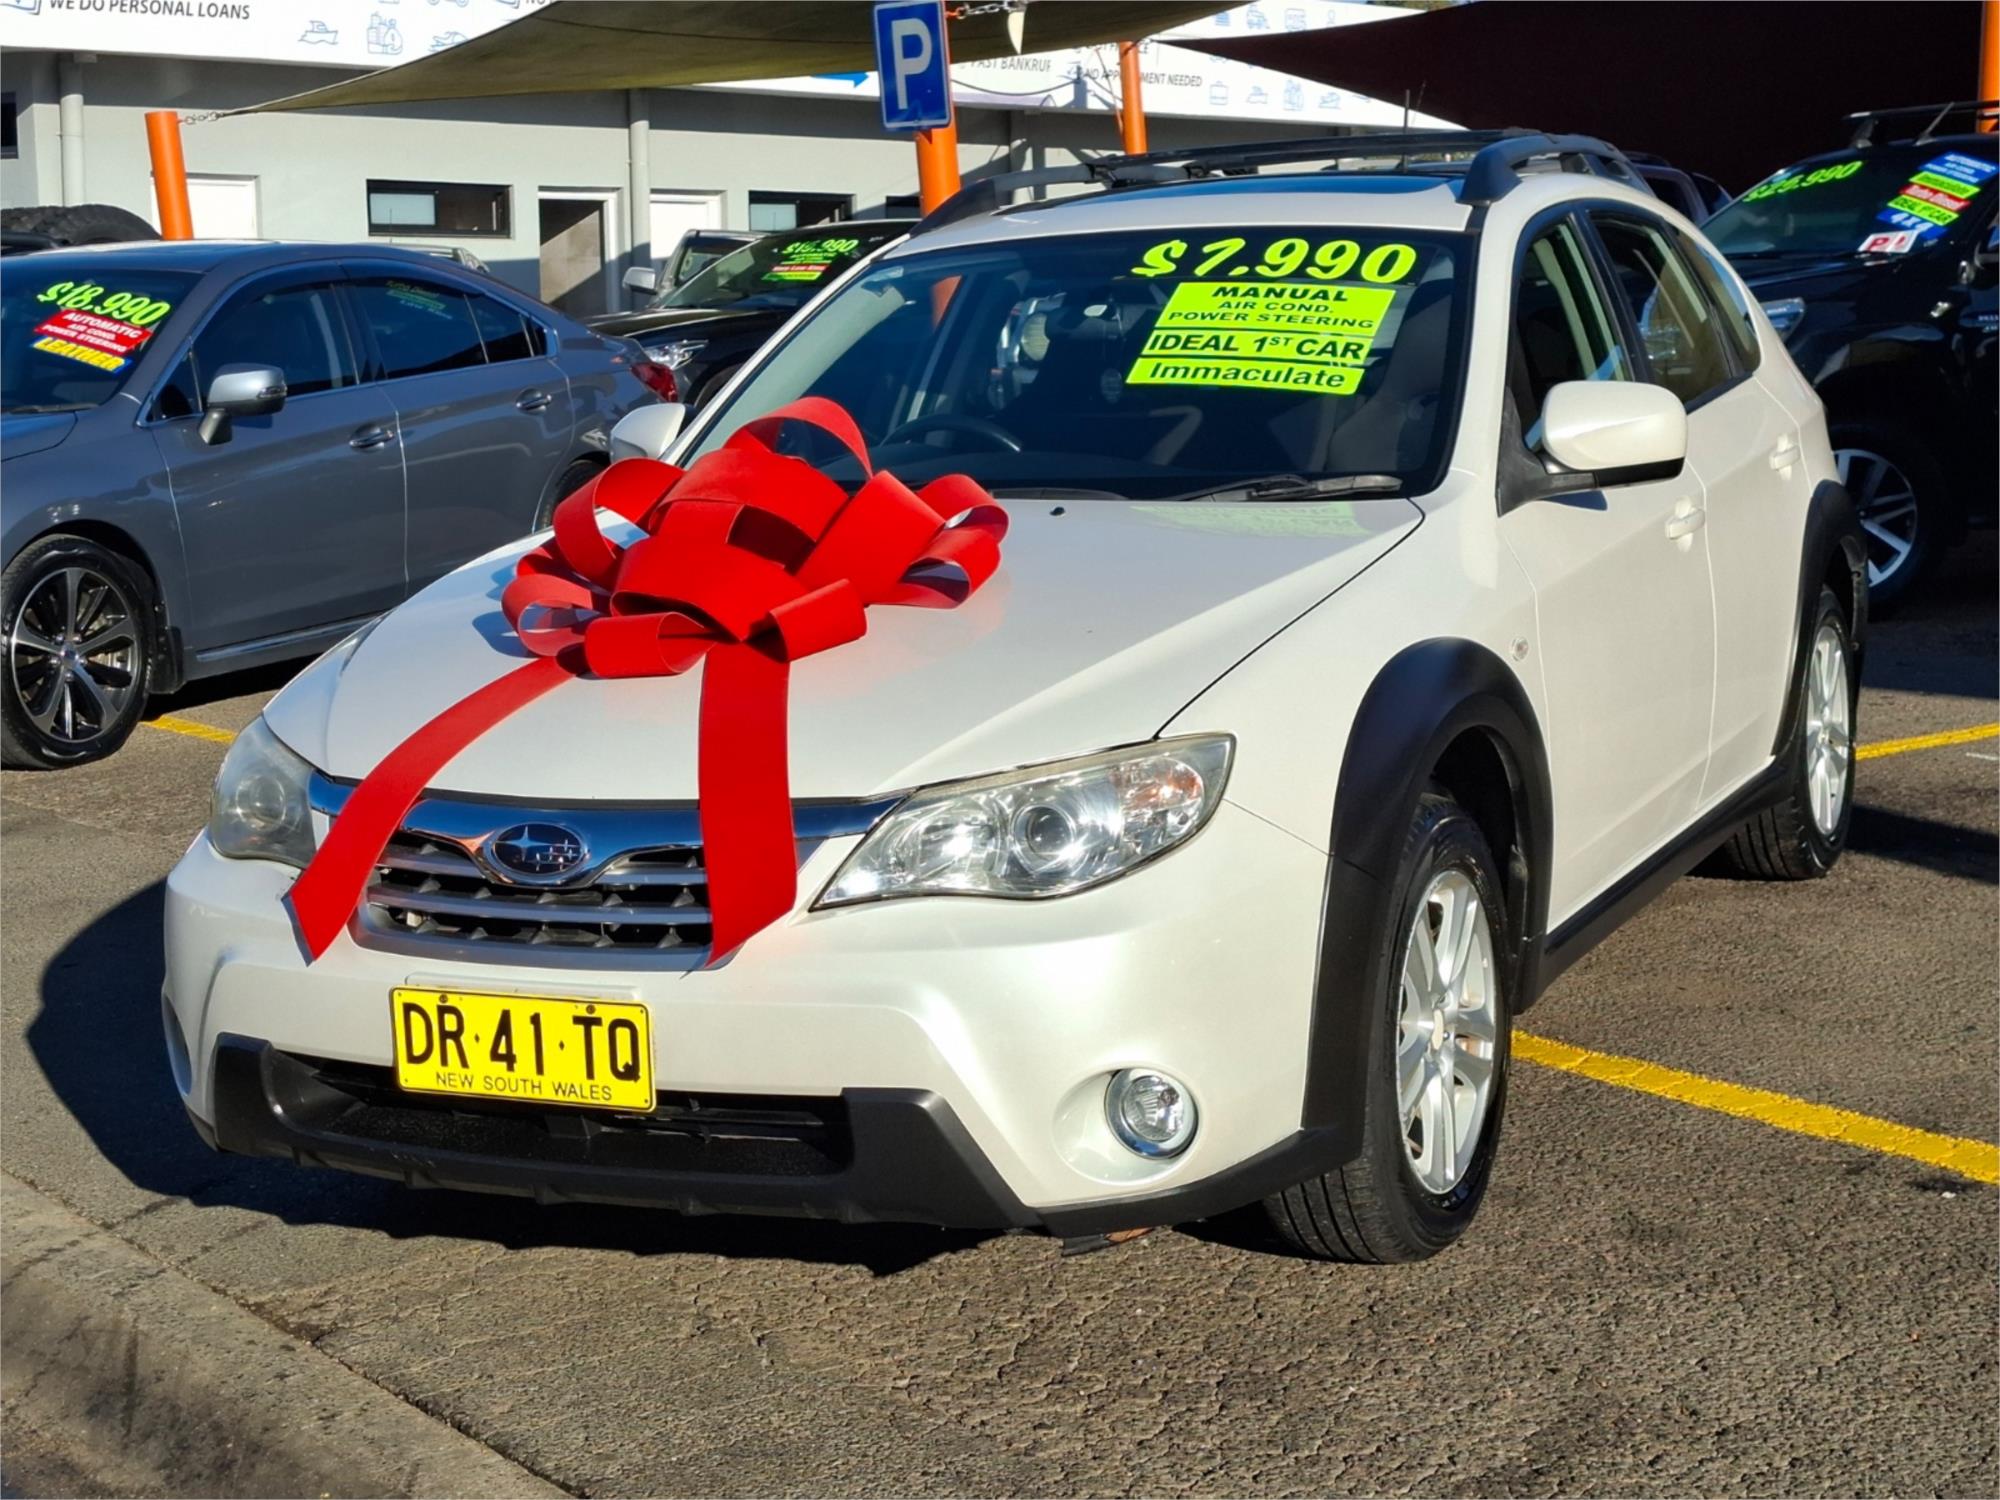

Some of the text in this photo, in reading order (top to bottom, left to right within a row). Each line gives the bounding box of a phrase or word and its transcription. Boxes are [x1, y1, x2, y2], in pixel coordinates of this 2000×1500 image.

[50, 0, 250, 20] WE DO PERSONAL LOANS
[891, 18, 932, 110] P
[1168, 74, 1203, 87] NEEDED
[37, 281, 171, 325] $18,990
[1212, 286, 1349, 303] MANUAL
[1218, 301, 1334, 314] AIR COND.
[62, 312, 143, 338] AUTOMATIC
[1168, 311, 1374, 329] POWER STEERING
[33, 336, 125, 372] LEATHER
[1149, 333, 1240, 352] IDEAL
[1295, 337, 1366, 360] CAR
[1149, 362, 1346, 388] Immaculate
[436, 1072, 612, 1101] NEW SOUTH WALES
